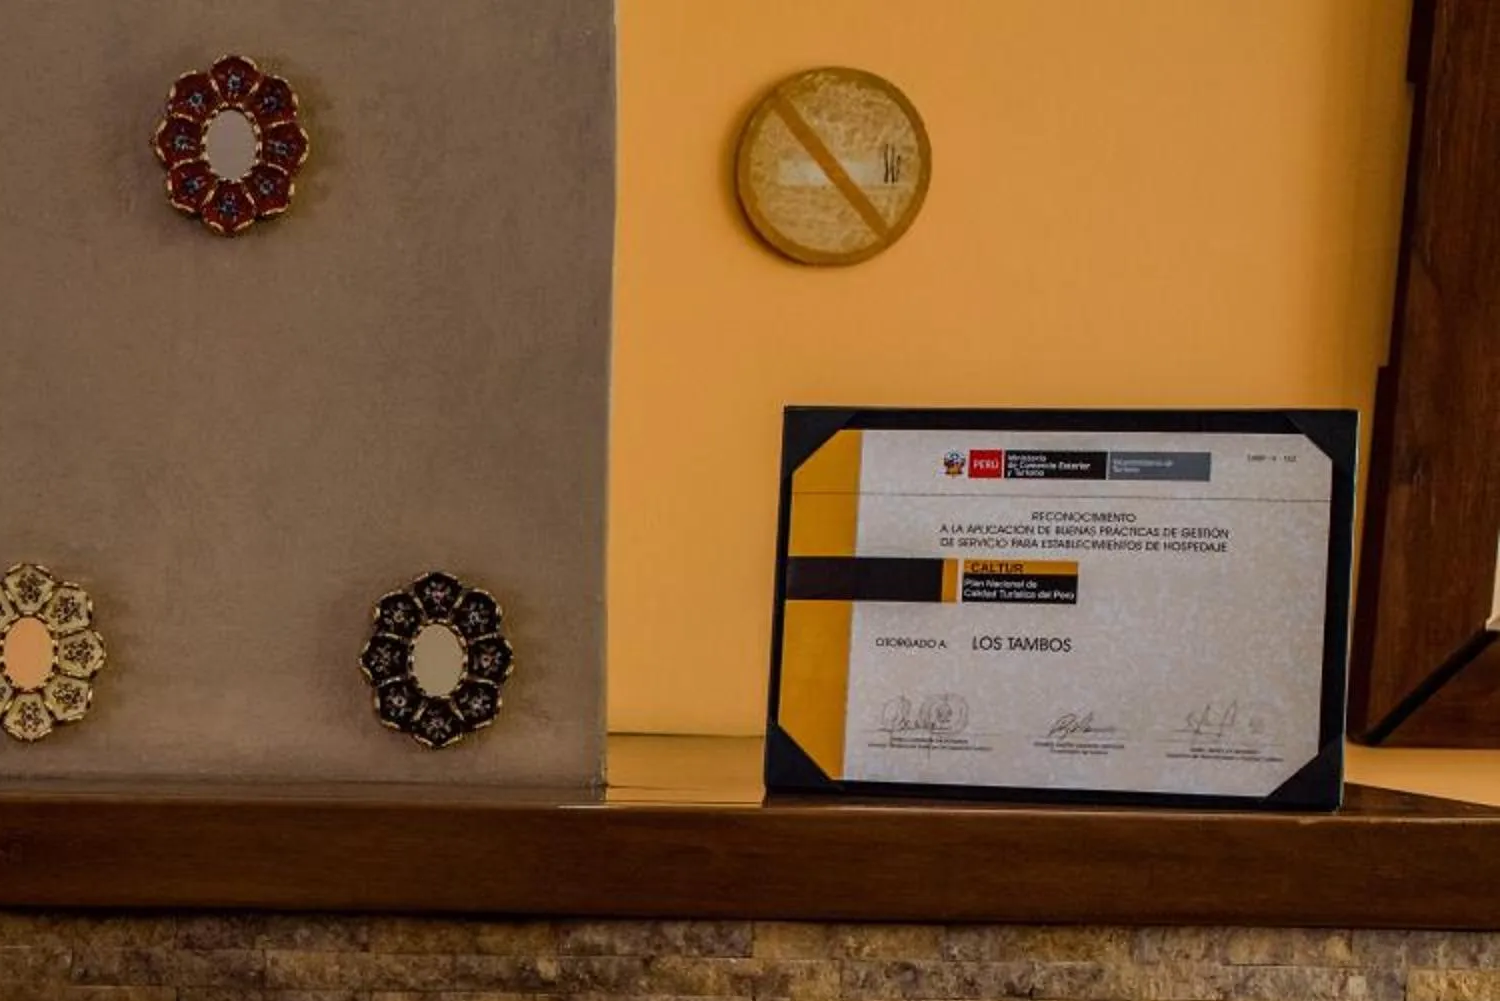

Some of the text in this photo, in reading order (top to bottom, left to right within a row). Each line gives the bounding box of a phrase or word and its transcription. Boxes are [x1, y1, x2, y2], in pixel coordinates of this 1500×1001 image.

[1031, 511, 1137, 523] RECONOCIMIENTO
[940, 523, 948, 533] A
[1038, 525, 1051, 535] DE
[1055, 525, 1097, 537] BUENAS
[1163, 527, 1178, 538] DE
[940, 537, 1229, 553] DE SERVICIO PARA ESTABLECIMIENTOS DE HOSPEDAJE
[971, 562, 1024, 573] CALTUR
[875, 637, 937, 649] OTORGADO
[972, 635, 1003, 651] LOS
[1008, 636, 1072, 653] TAMBOS
